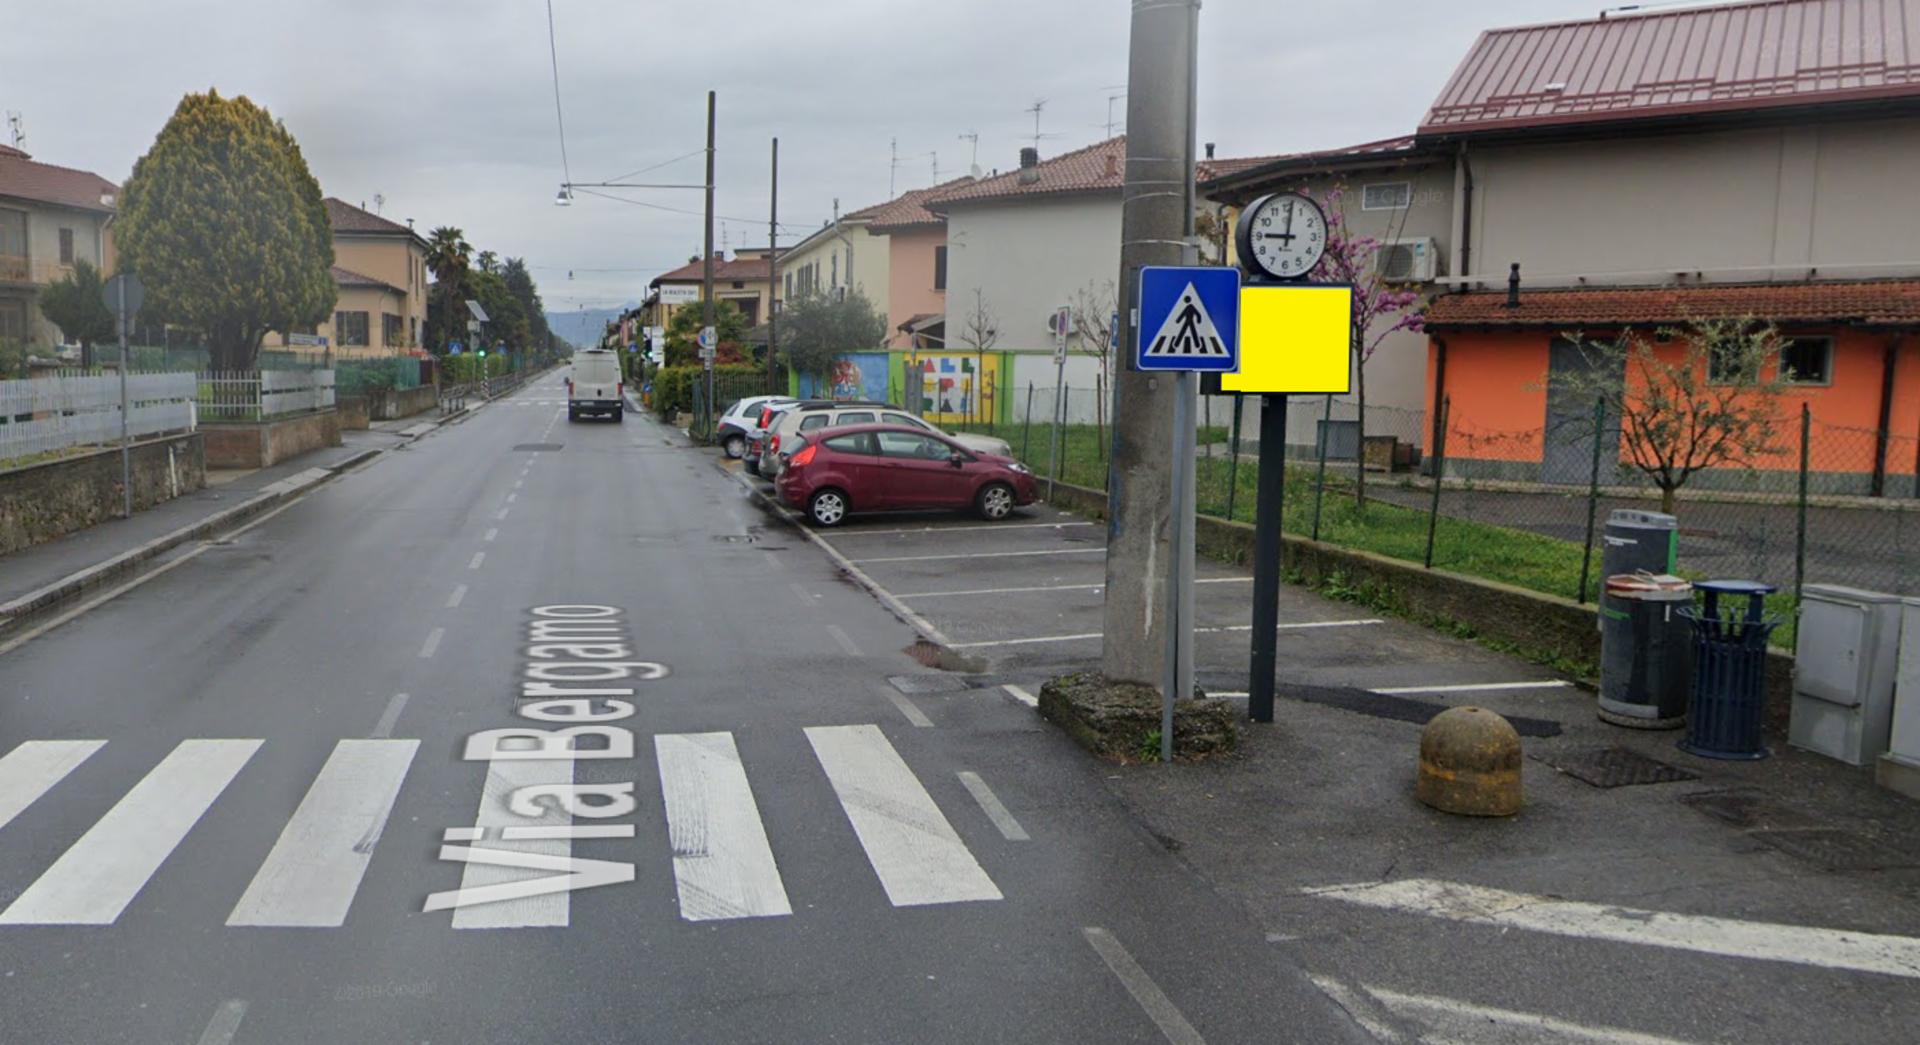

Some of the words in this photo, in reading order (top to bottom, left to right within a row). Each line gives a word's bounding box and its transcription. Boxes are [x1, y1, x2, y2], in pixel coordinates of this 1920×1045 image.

[1271, 207, 1279, 216] 11
[1299, 207, 1303, 216] 1
[1261, 217, 1271, 227] 10
[1307, 218, 1314, 227] 2
[1256, 231, 1263, 241] 9
[1311, 232, 1317, 241] 3
[1259, 246, 1266, 255] 8
[1305, 246, 1312, 255] 4
[1270, 257, 1276, 265] 7
[1281, 260, 1288, 269] 6
[1295, 257, 1302, 266] 5
